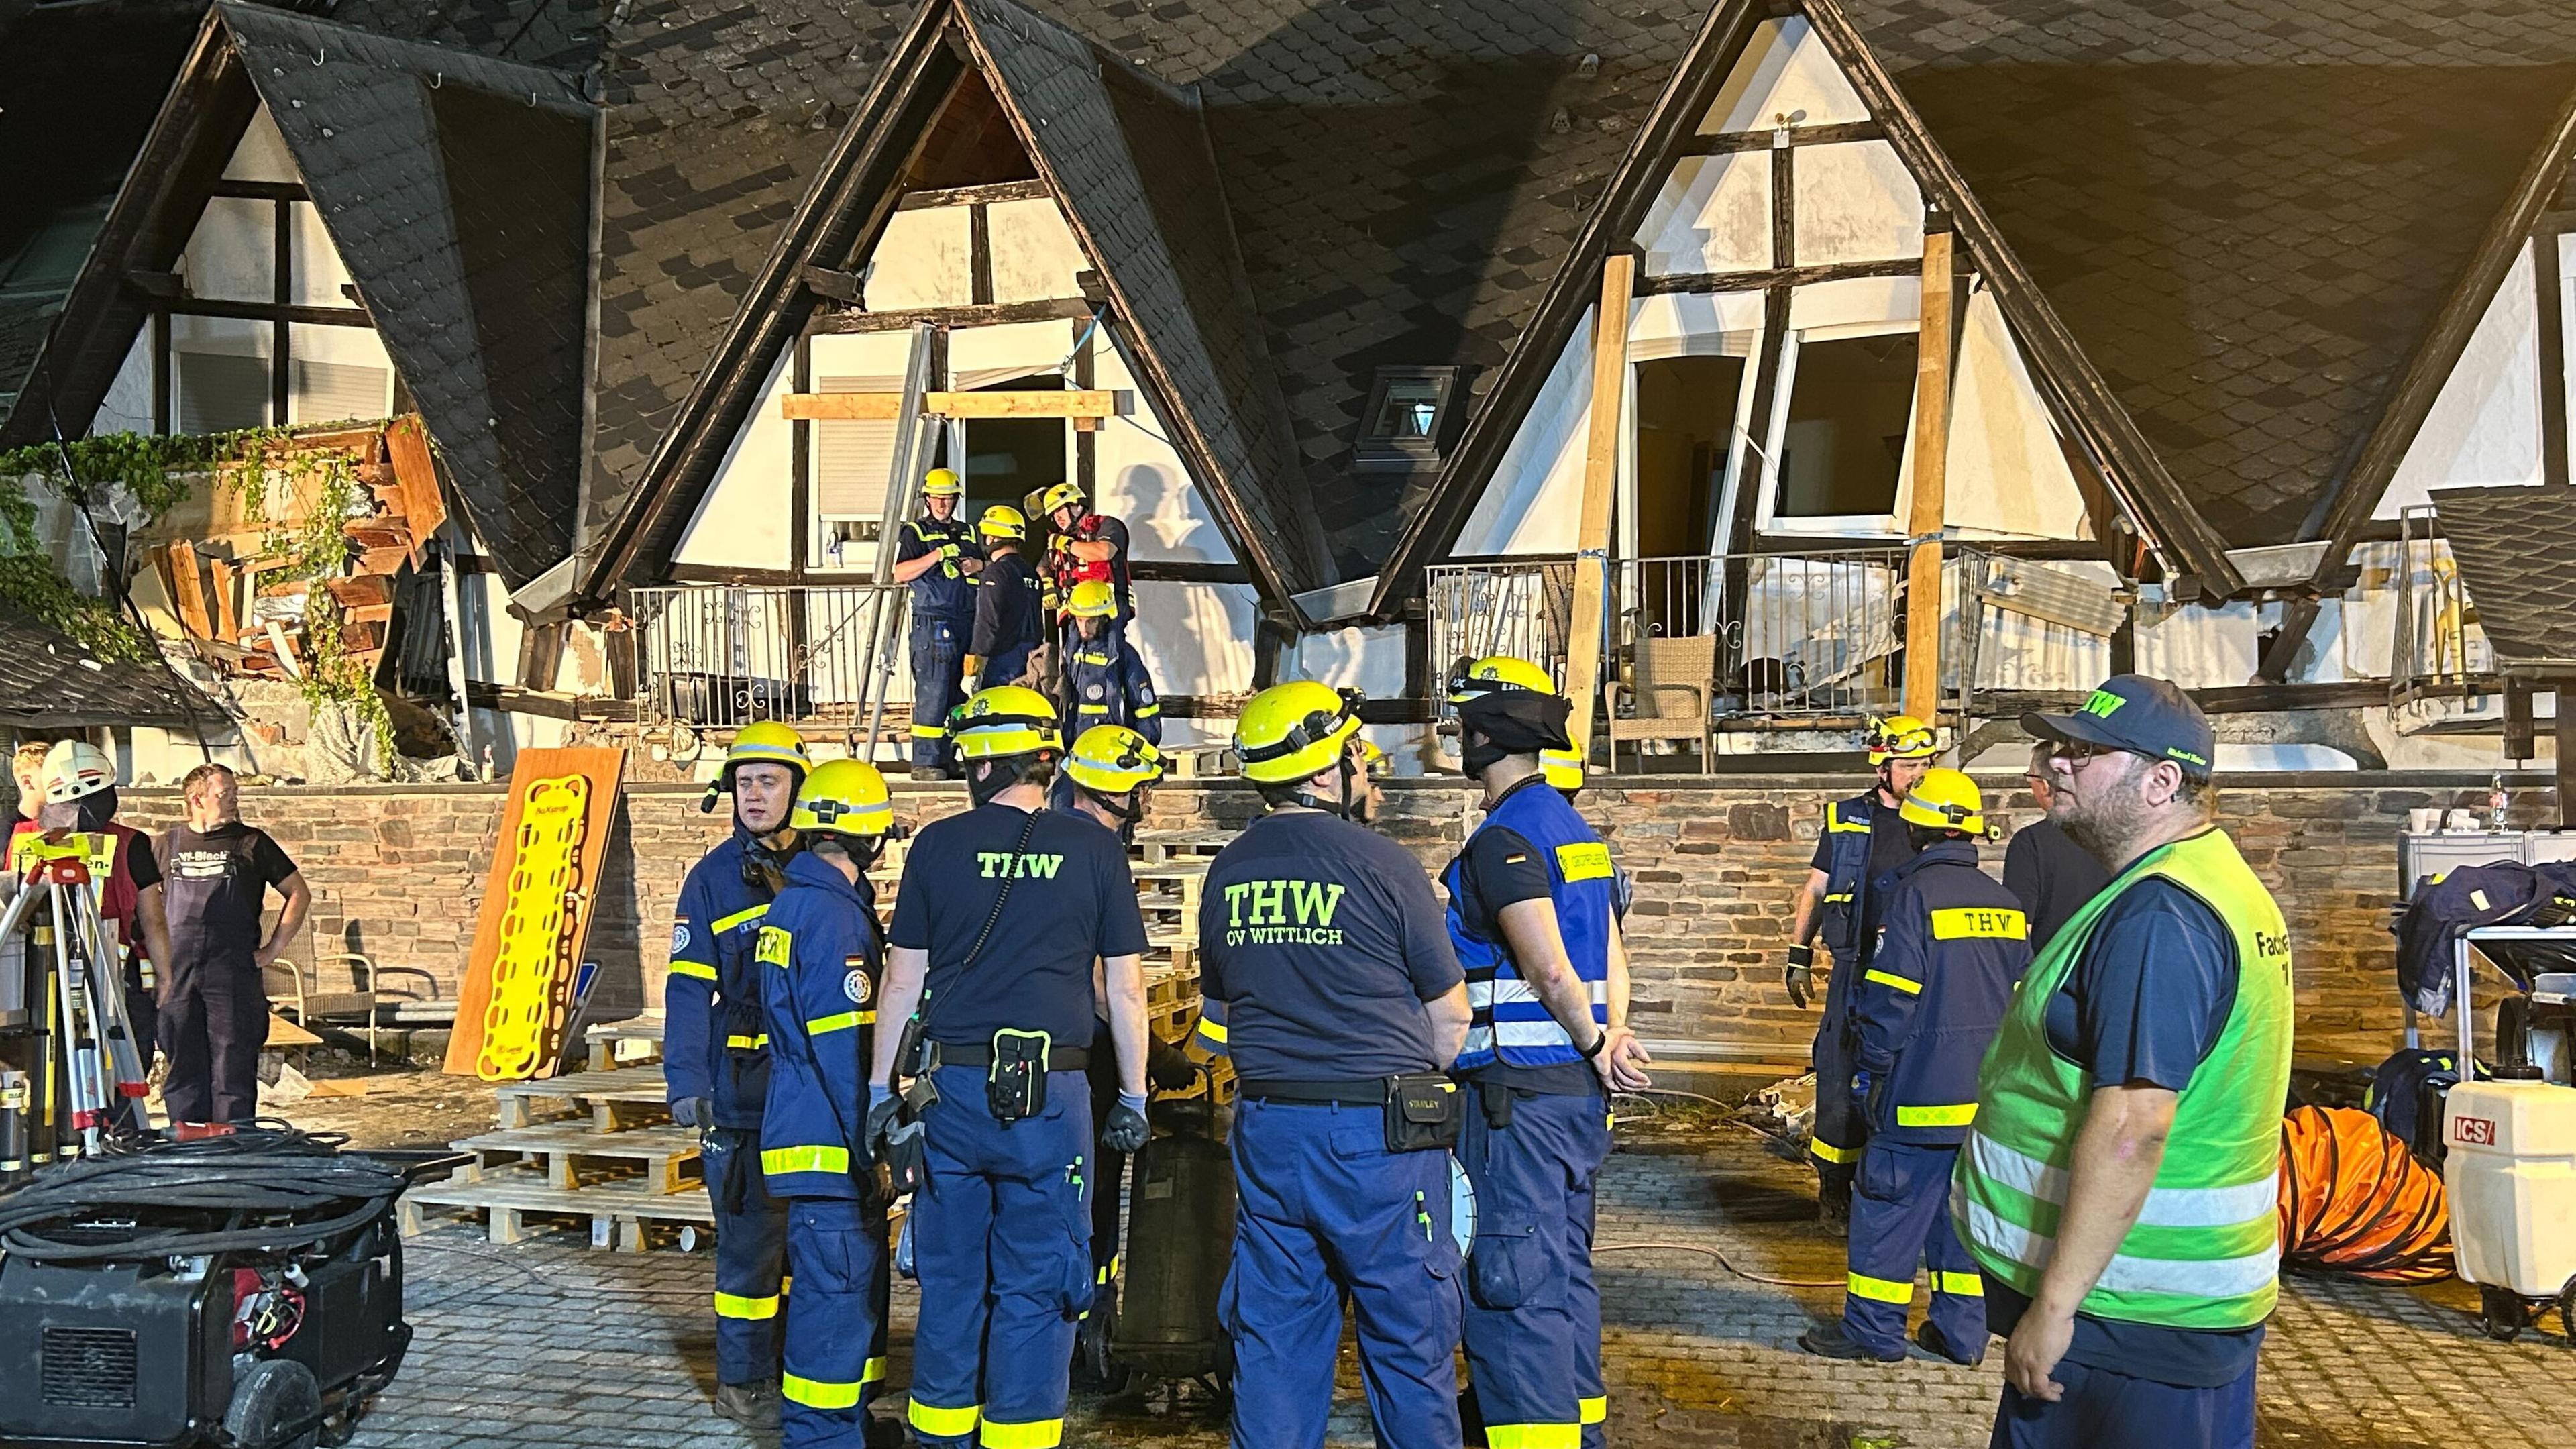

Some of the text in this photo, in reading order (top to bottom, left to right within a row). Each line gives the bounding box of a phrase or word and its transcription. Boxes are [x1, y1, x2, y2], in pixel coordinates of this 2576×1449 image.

[977, 852, 1064, 879] THW
[1224, 880, 1346, 927] THW
[1964, 912, 2012, 932] THW
[1226, 926, 1344, 947] OV WITTLICH
[2456, 1118, 2487, 1142] ICS
